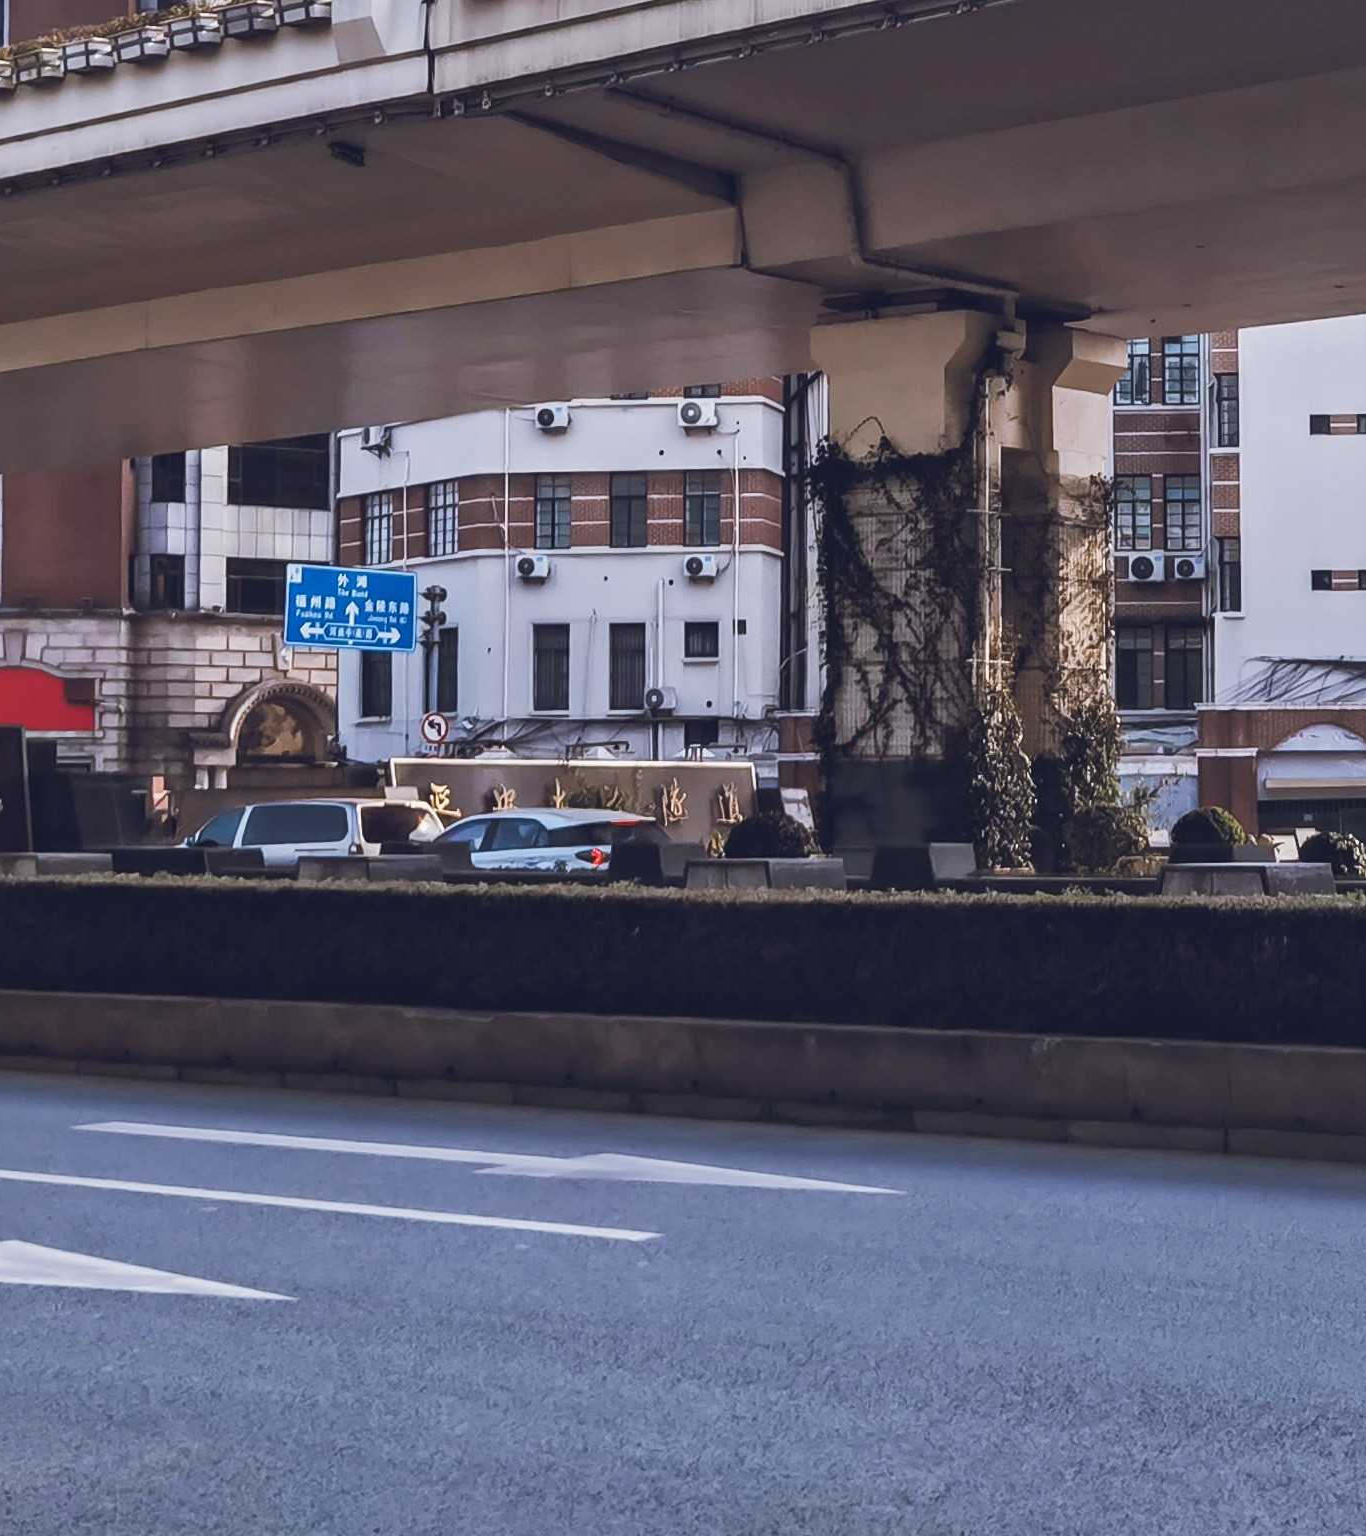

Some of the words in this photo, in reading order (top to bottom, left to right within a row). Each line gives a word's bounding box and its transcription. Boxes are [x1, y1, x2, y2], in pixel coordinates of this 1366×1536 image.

[337, 573, 368, 589] 外滩
[295, 594, 335, 610] 福州路
[364, 599, 409, 615] 金陵东路
